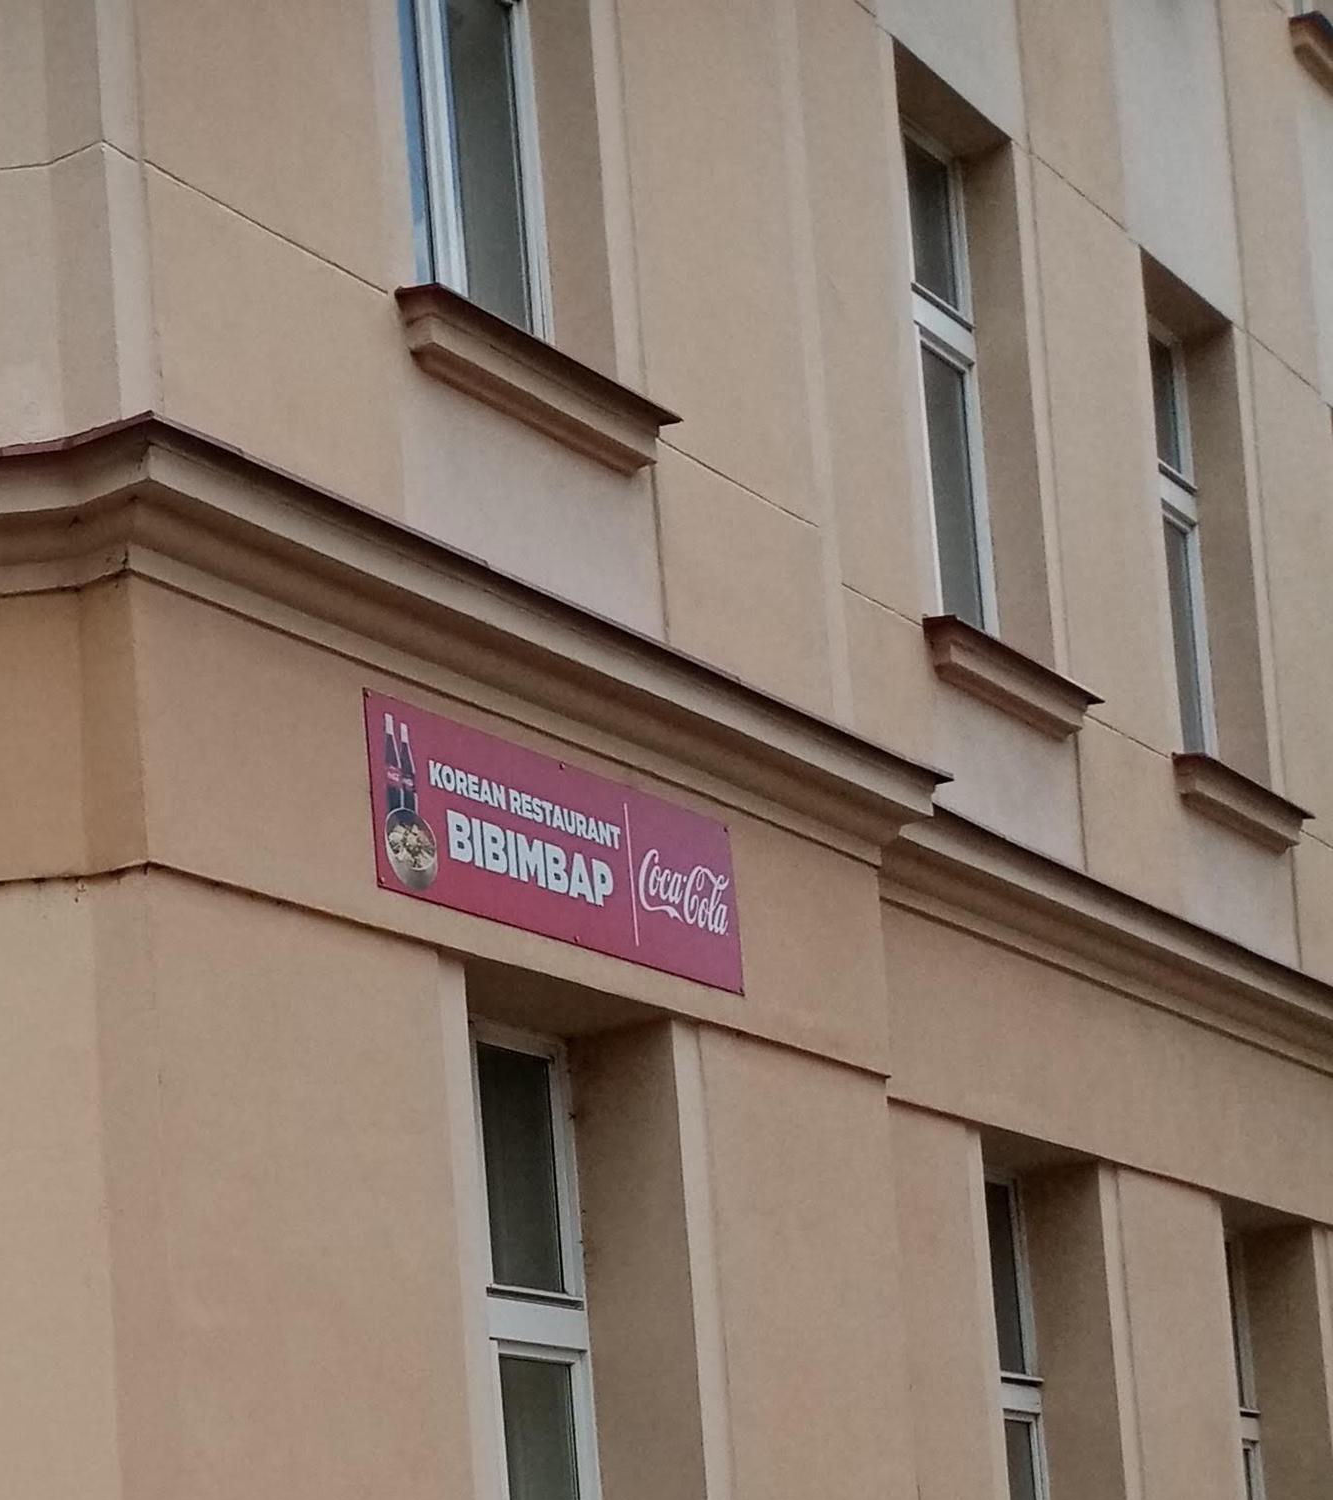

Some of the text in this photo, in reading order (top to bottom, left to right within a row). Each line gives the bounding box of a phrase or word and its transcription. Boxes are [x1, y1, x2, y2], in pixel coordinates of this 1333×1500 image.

[427, 759, 621, 850] KOREAN RESTAURANT
[445, 808, 614, 907] BIBIMBAP
[638, 848, 730, 937] Coca-Cola
